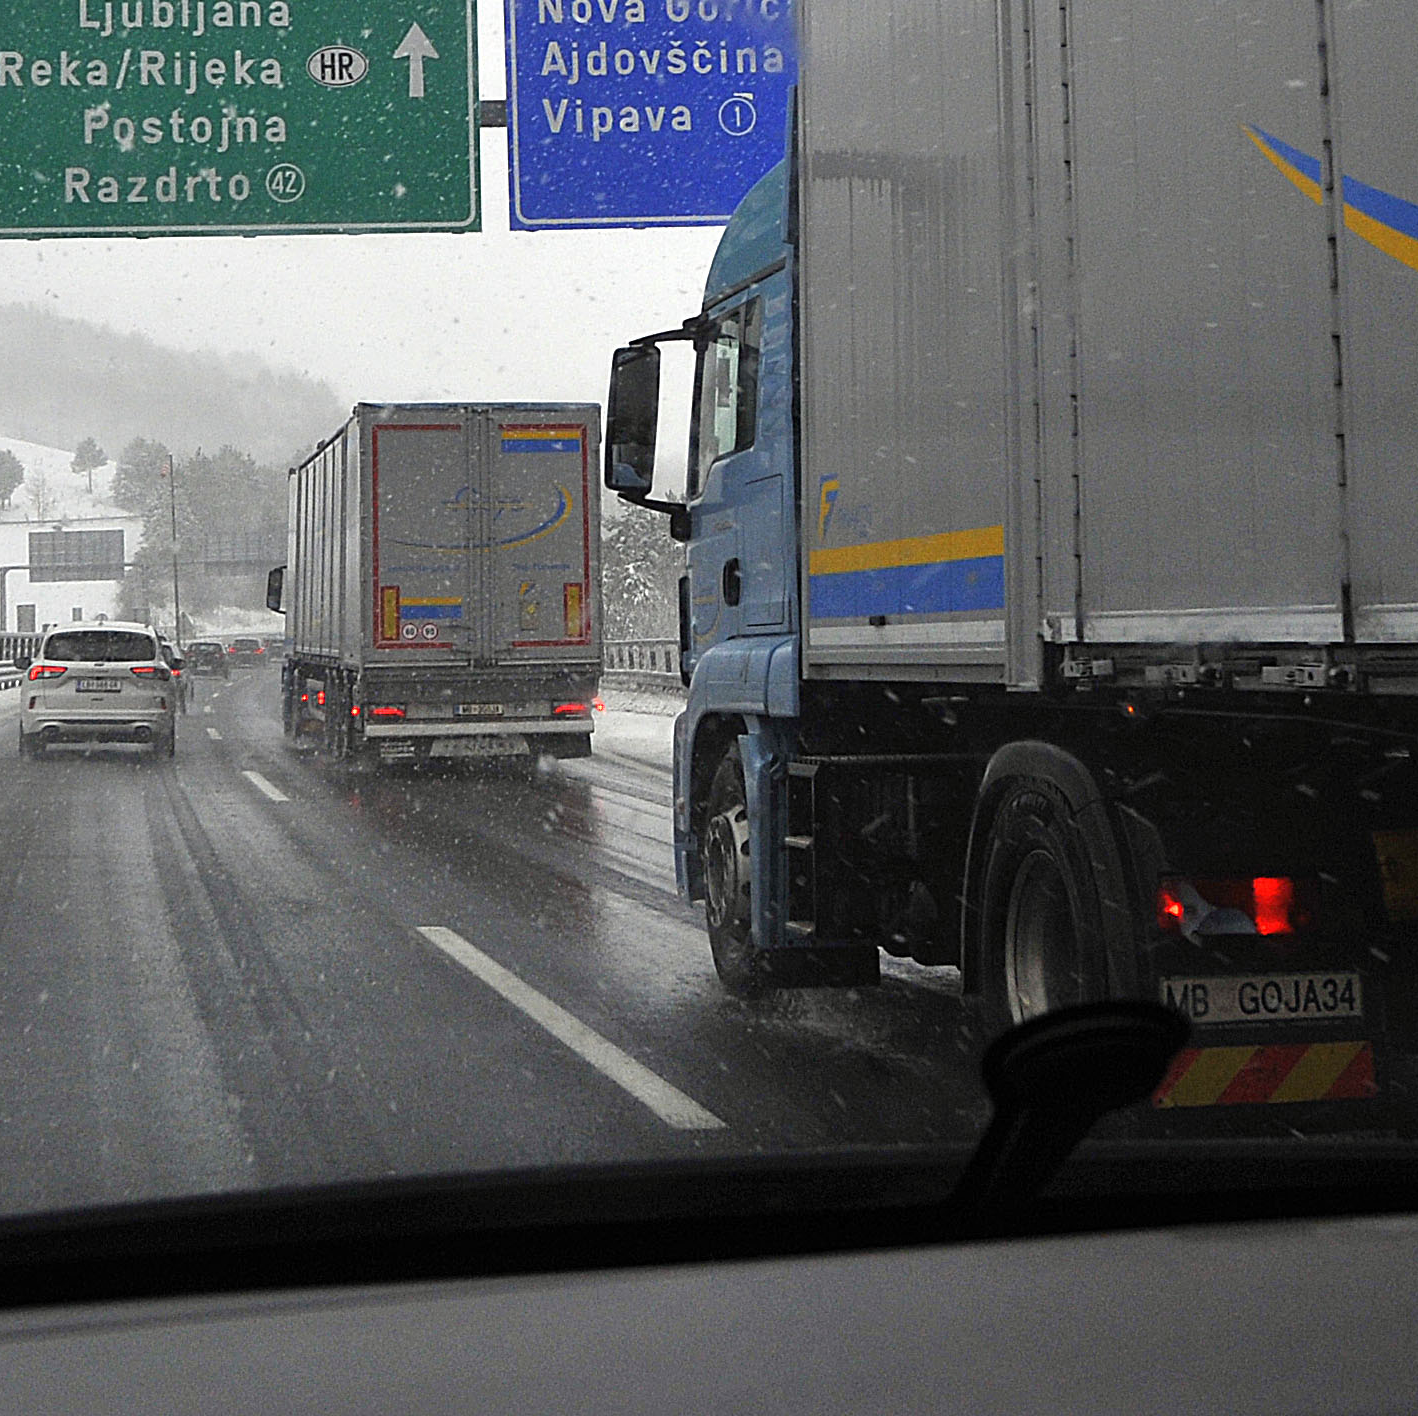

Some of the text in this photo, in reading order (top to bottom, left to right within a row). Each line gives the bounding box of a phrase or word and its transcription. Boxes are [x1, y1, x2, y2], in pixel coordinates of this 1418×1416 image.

[320, 52, 354, 81] HR
[541, 40, 784, 85] Ajdovščina
[83, 108, 287, 152] Postojna
[542, 98, 692, 142] Vipava
[64, 166, 297, 203] Razdrto 42
[1165, 978, 1356, 1018] MB GOJA34
